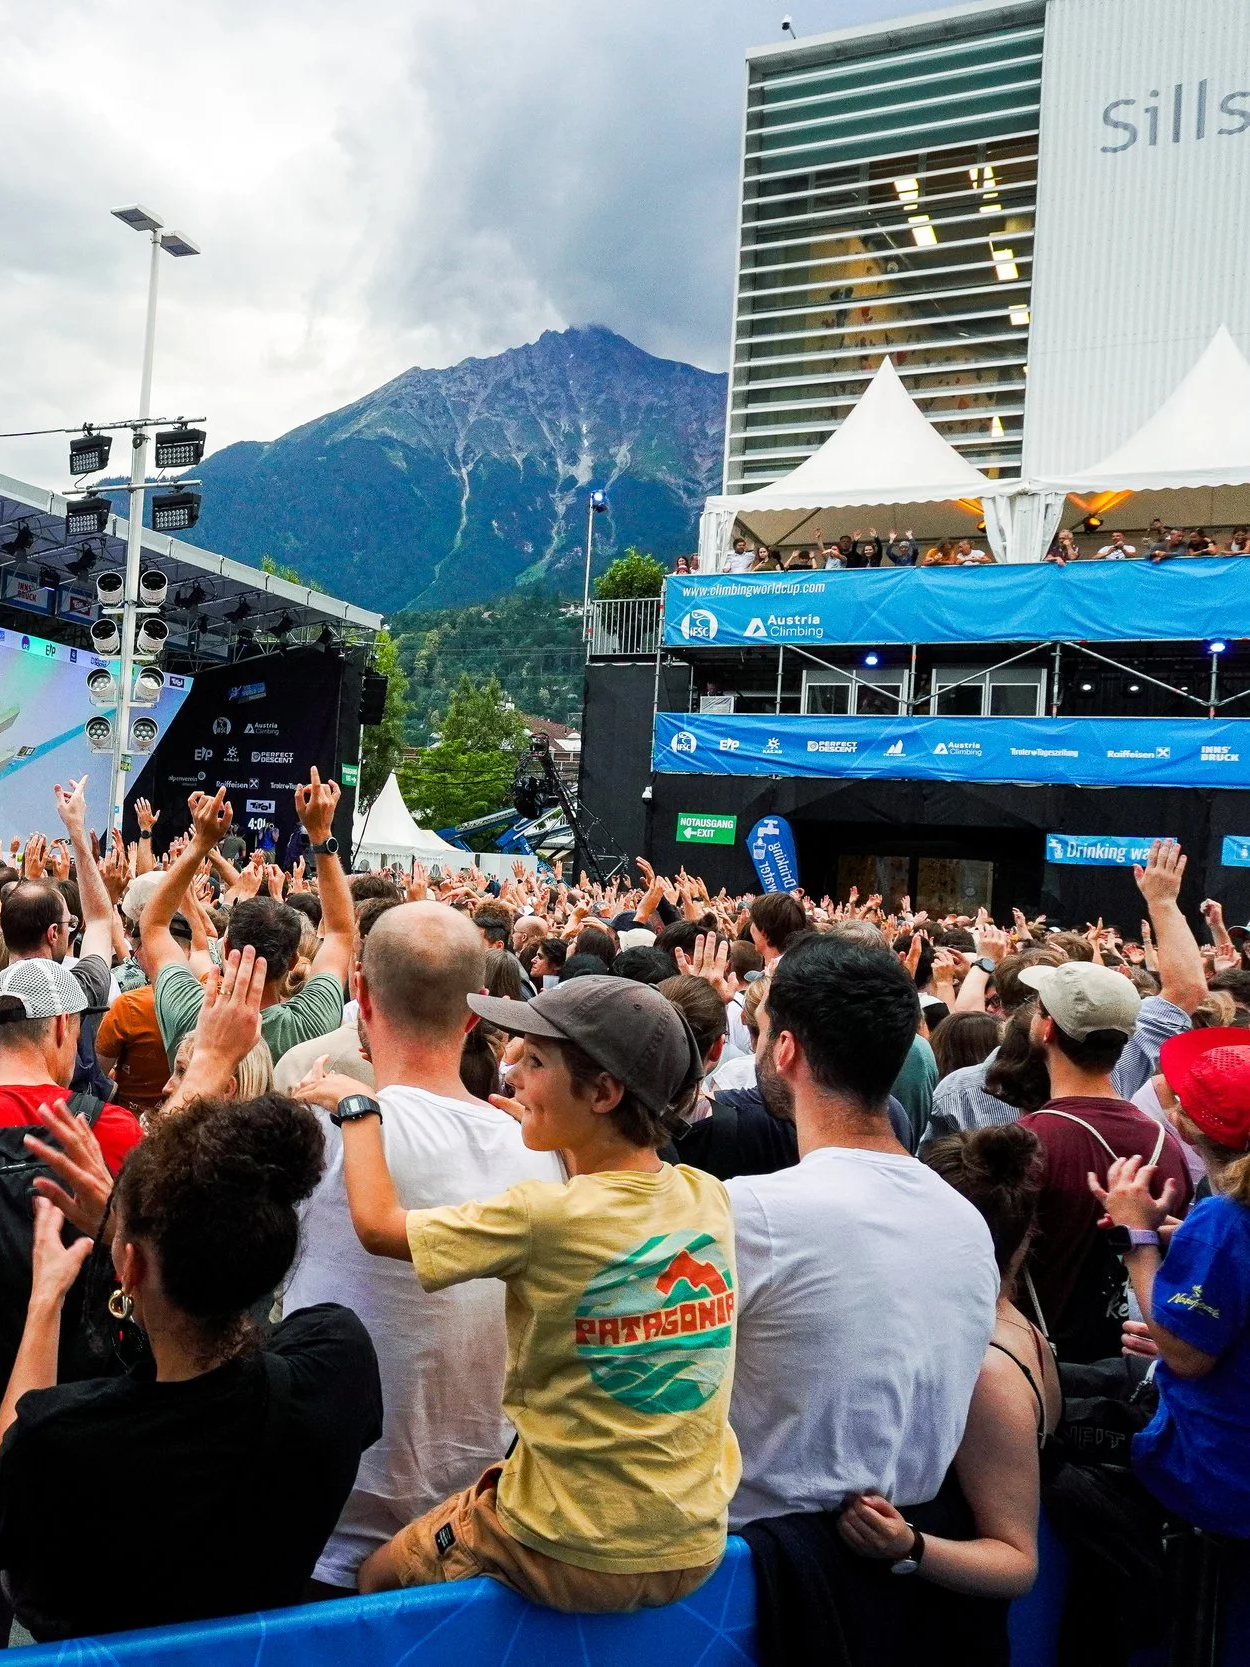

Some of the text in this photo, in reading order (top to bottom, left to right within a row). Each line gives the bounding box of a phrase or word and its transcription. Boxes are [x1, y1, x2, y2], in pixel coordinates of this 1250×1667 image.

[1101, 78, 1250, 153] Sills
[683, 582, 825, 598] www.climbingworldcup.com
[768, 614, 820, 626] Austria
[689, 626, 710, 637] IFSC
[770, 625, 824, 639] Climbing
[255, 728, 279, 736] Climbing
[677, 743, 691, 752] IFSC
[1201, 746, 1231, 754] INNS'
[949, 748, 982, 757] Climbing
[1107, 750, 1154, 759] Raiffeisen
[1201, 753, 1239, 762] BRUCK
[168, 775, 198, 783] alpenverein
[216, 780, 248, 789] Raiffeisen
[250, 802, 271, 811] Tirol
[680, 817, 734, 829] NOTAUSGANG
[697, 829, 715, 838] EXIT
[1067, 841, 1131, 863] Drinking
[575, 1291, 735, 1345] PATAGONIA
